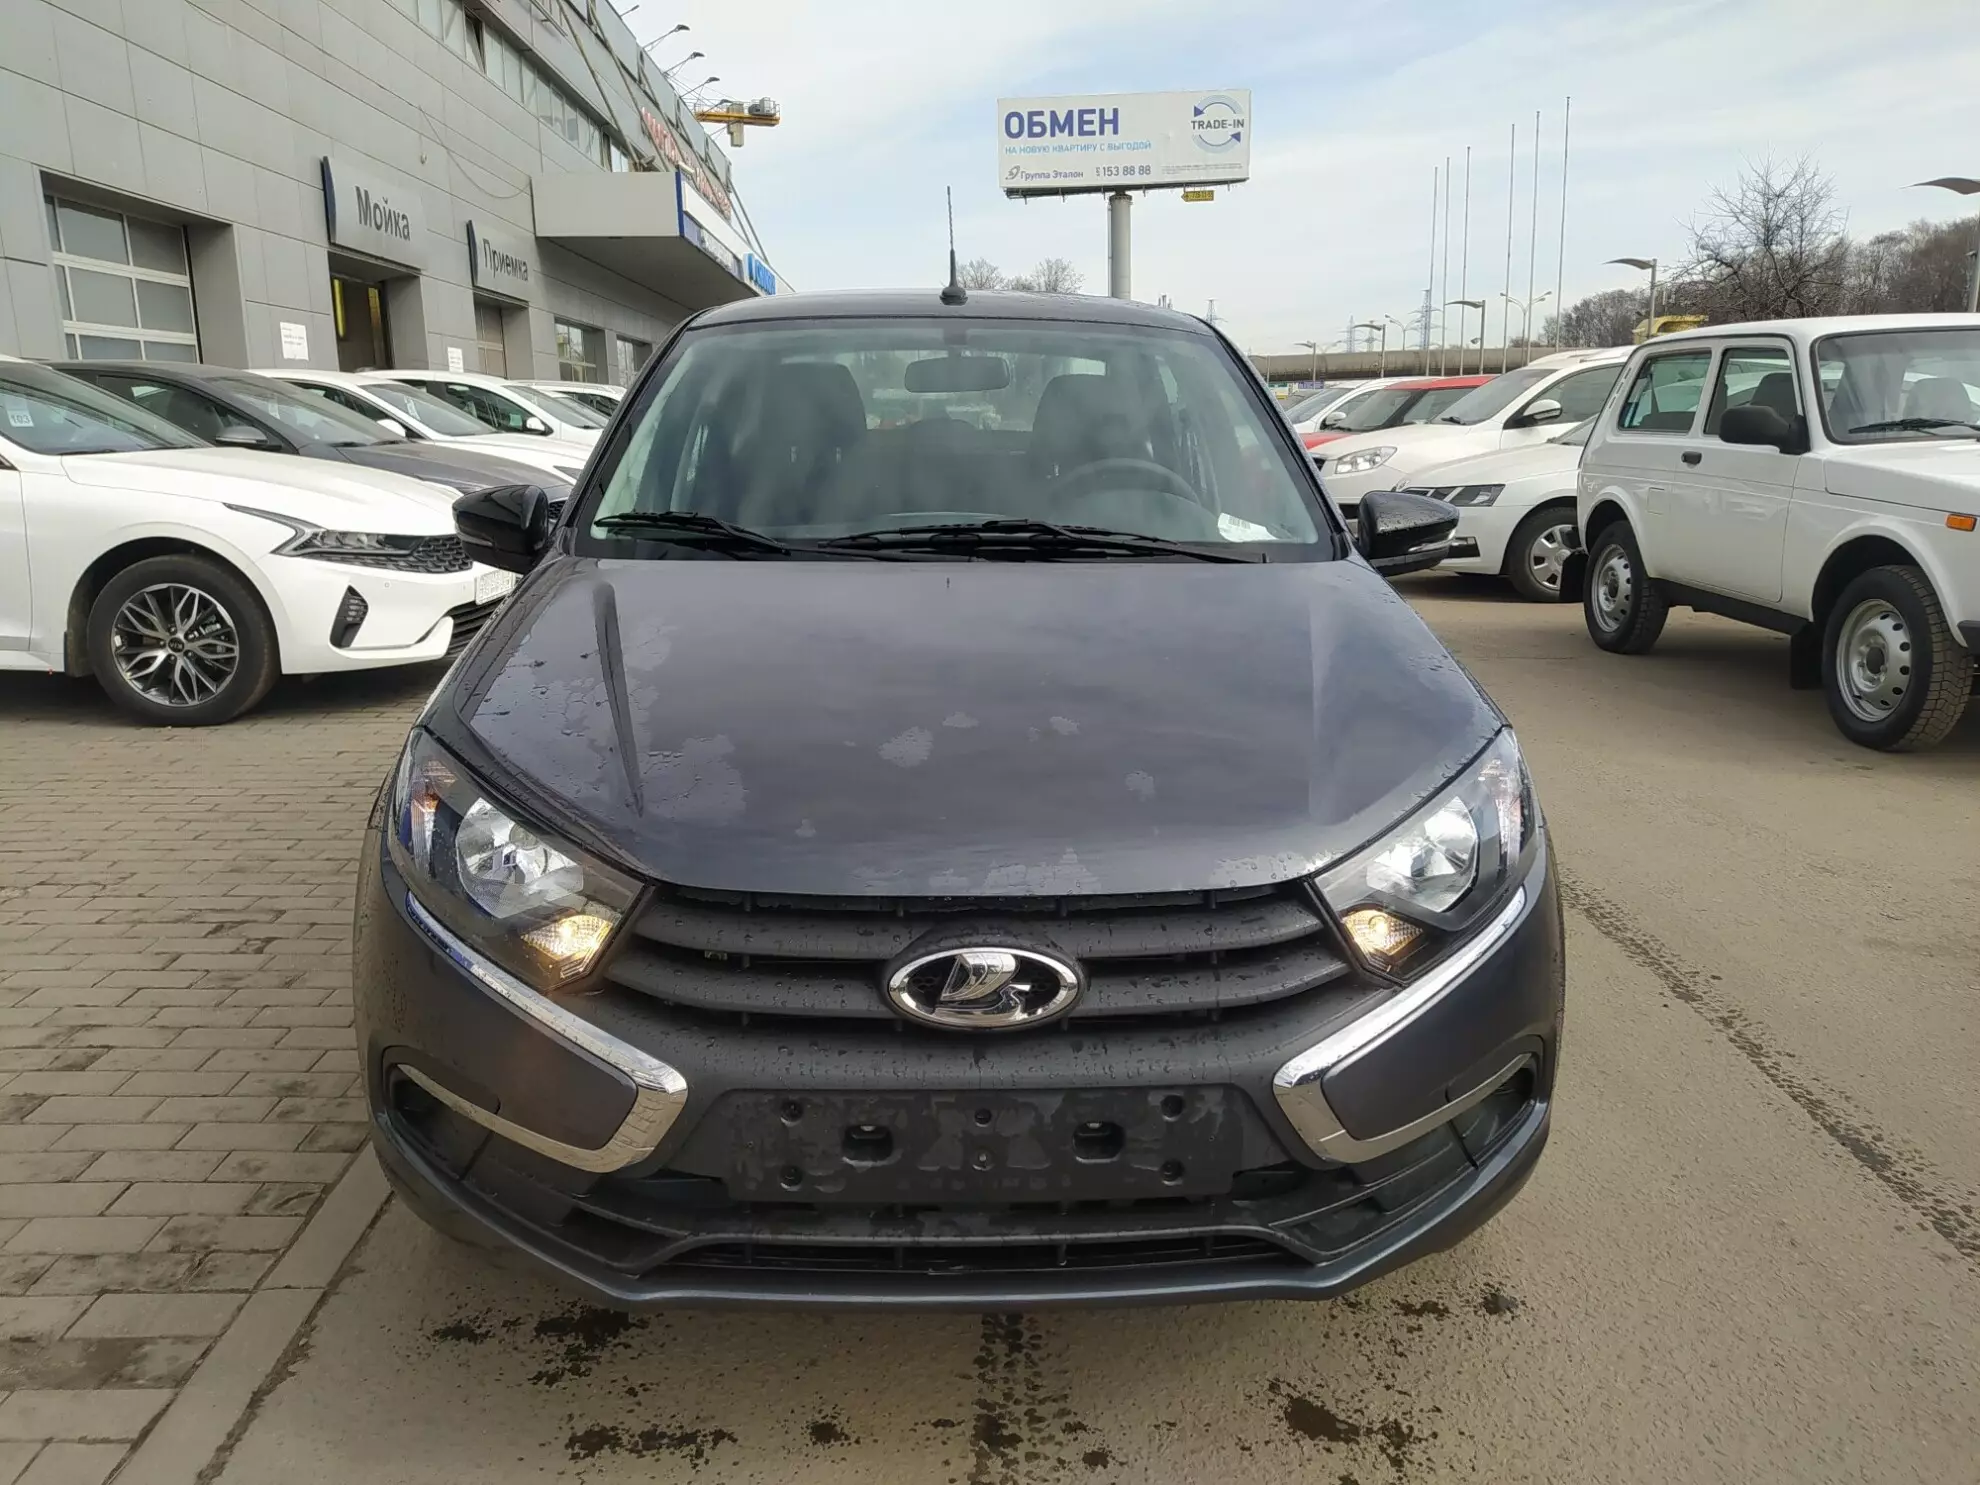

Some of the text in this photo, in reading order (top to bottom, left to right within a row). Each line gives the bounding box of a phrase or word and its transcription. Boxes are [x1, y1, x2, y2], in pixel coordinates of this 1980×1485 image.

[1005, 107, 1119, 139] ОБМЕН
[1191, 118, 1245, 131] TRADE-IN
[1005, 140, 1151, 155] НА НОВУЮ КВАРТИРУ С ВЫГОДОЙ
[1020, 169, 1084, 181] Группа Эталон
[1102, 165, 1120, 177] 153
[1122, 165, 1136, 176] 88
[1138, 164, 1152, 176] 88
[355, 186, 411, 241] Мойка
[483, 238, 529, 282] Приемка
